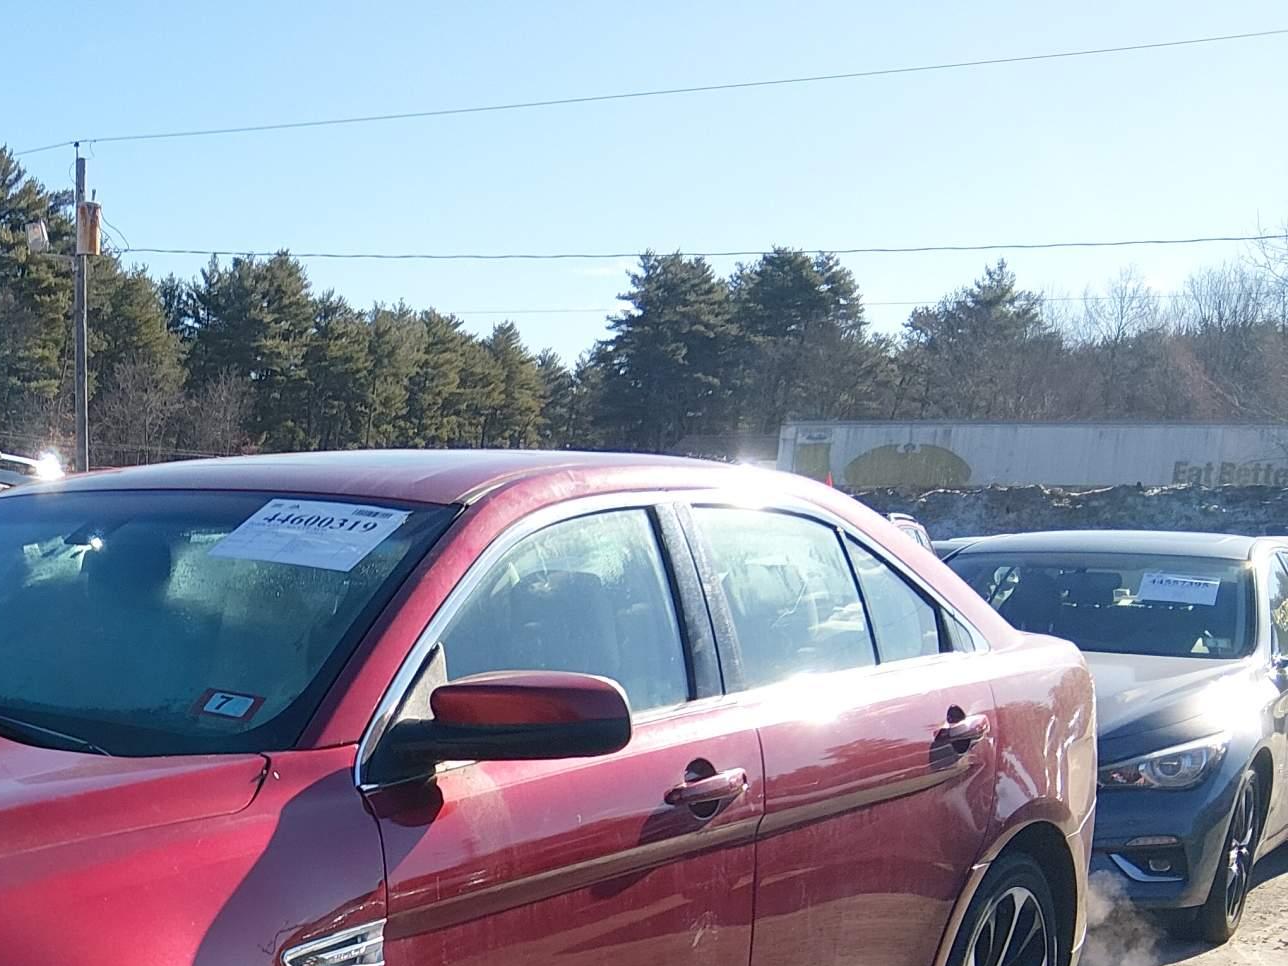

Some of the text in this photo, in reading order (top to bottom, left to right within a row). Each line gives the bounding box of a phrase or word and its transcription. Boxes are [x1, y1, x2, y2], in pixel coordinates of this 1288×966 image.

[1173, 462, 1214, 485] Eat
[263, 512, 378, 532] 44600319
[215, 695, 234, 710] 7
